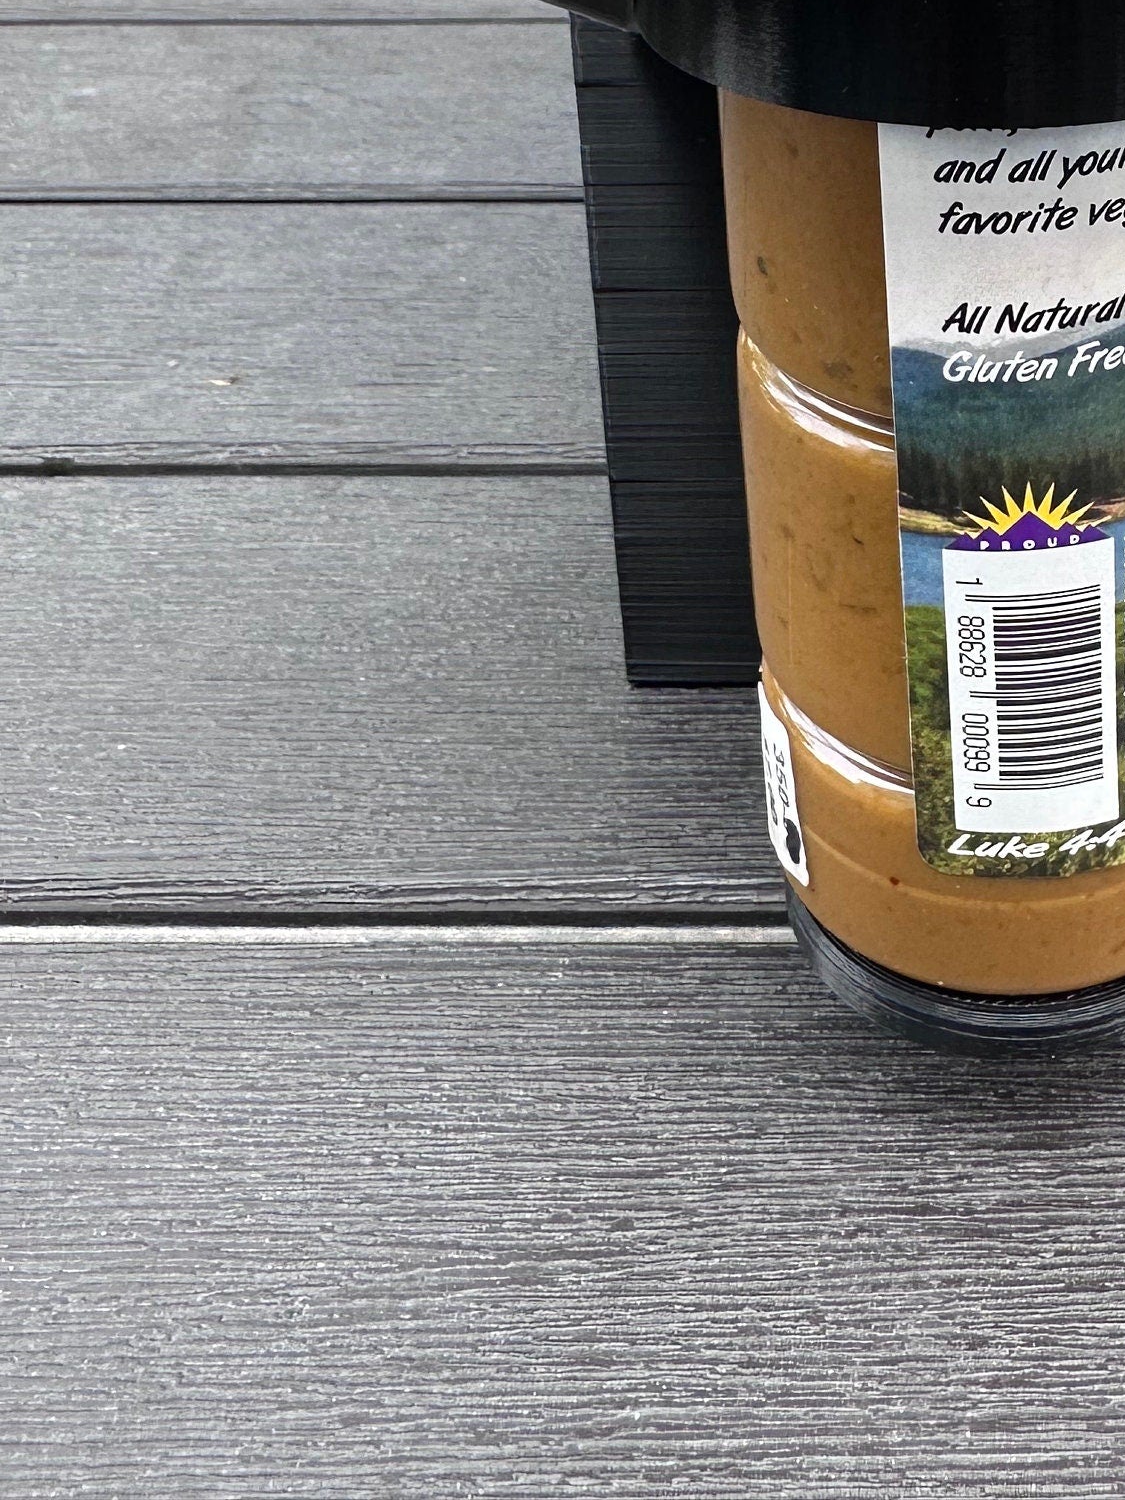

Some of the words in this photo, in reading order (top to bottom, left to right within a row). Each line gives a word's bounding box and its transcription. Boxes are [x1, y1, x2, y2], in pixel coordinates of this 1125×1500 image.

[933, 147, 1007, 184] and
[1008, 149, 1057, 183] all
[938, 197, 1079, 235] favorite
[942, 302, 992, 335] All
[942, 350, 1059, 383] Gluten
[979, 533, 1081, 551] PROUD
[955, 577, 983, 586] 1
[957, 615, 986, 679] 88628
[961, 712, 990, 773] 00099
[966, 796, 993, 809] 9
[947, 833, 1050, 859] Luke
